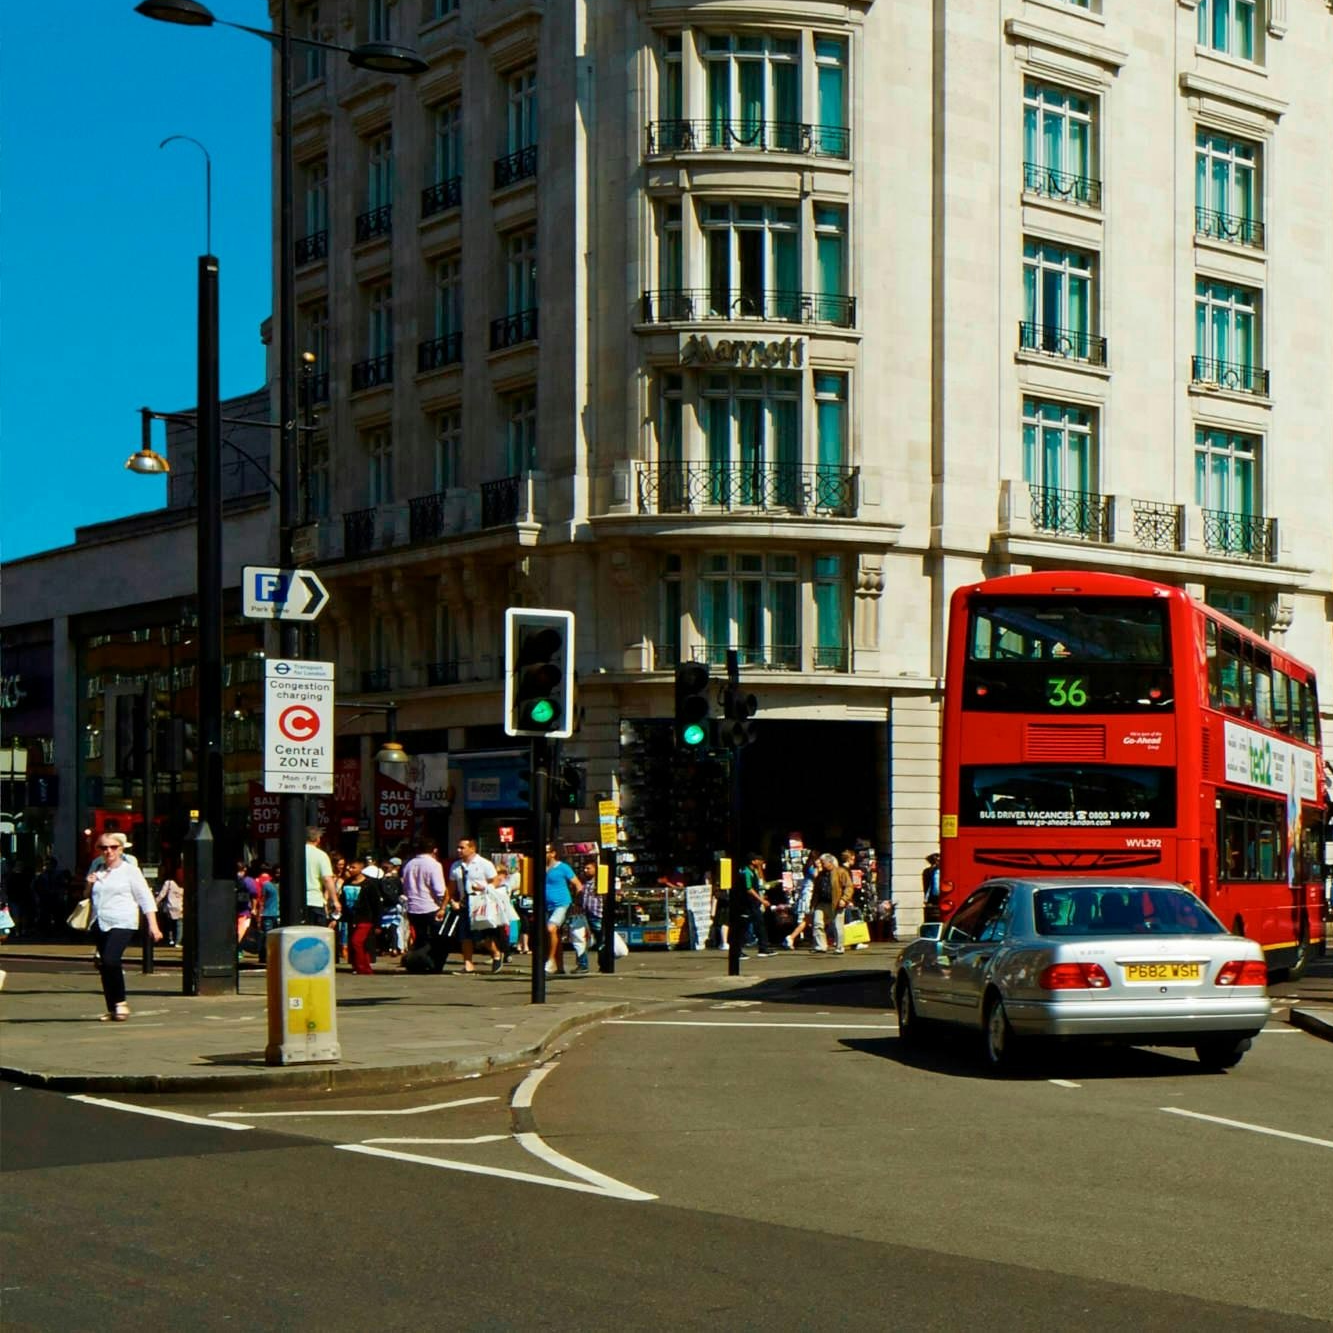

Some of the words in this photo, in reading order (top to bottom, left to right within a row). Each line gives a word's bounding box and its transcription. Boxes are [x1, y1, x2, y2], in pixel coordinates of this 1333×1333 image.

[680, 333, 804, 367] Marriott
[261, 576, 281, 600] P
[269, 680, 330, 691] Congestion
[276, 691, 323, 701] charging
[1048, 678, 1088, 707] 36
[1123, 736, 1162, 745] Go-Ahead
[274, 744, 325, 756] Central
[279, 757, 320, 768] ZONE
[381, 789, 412, 801] SALE
[379, 802, 413, 817] 50%
[979, 810, 996, 819] BUS
[997, 810, 1027, 819] DRIVER
[1027, 810, 1074, 819] VACANCIES
[384, 819, 409, 831] OFF
[1016, 819, 1112, 827] www.go-ahead-london.com
[1125, 838, 1162, 848] WVL292
[1128, 964, 1168, 978] P682
